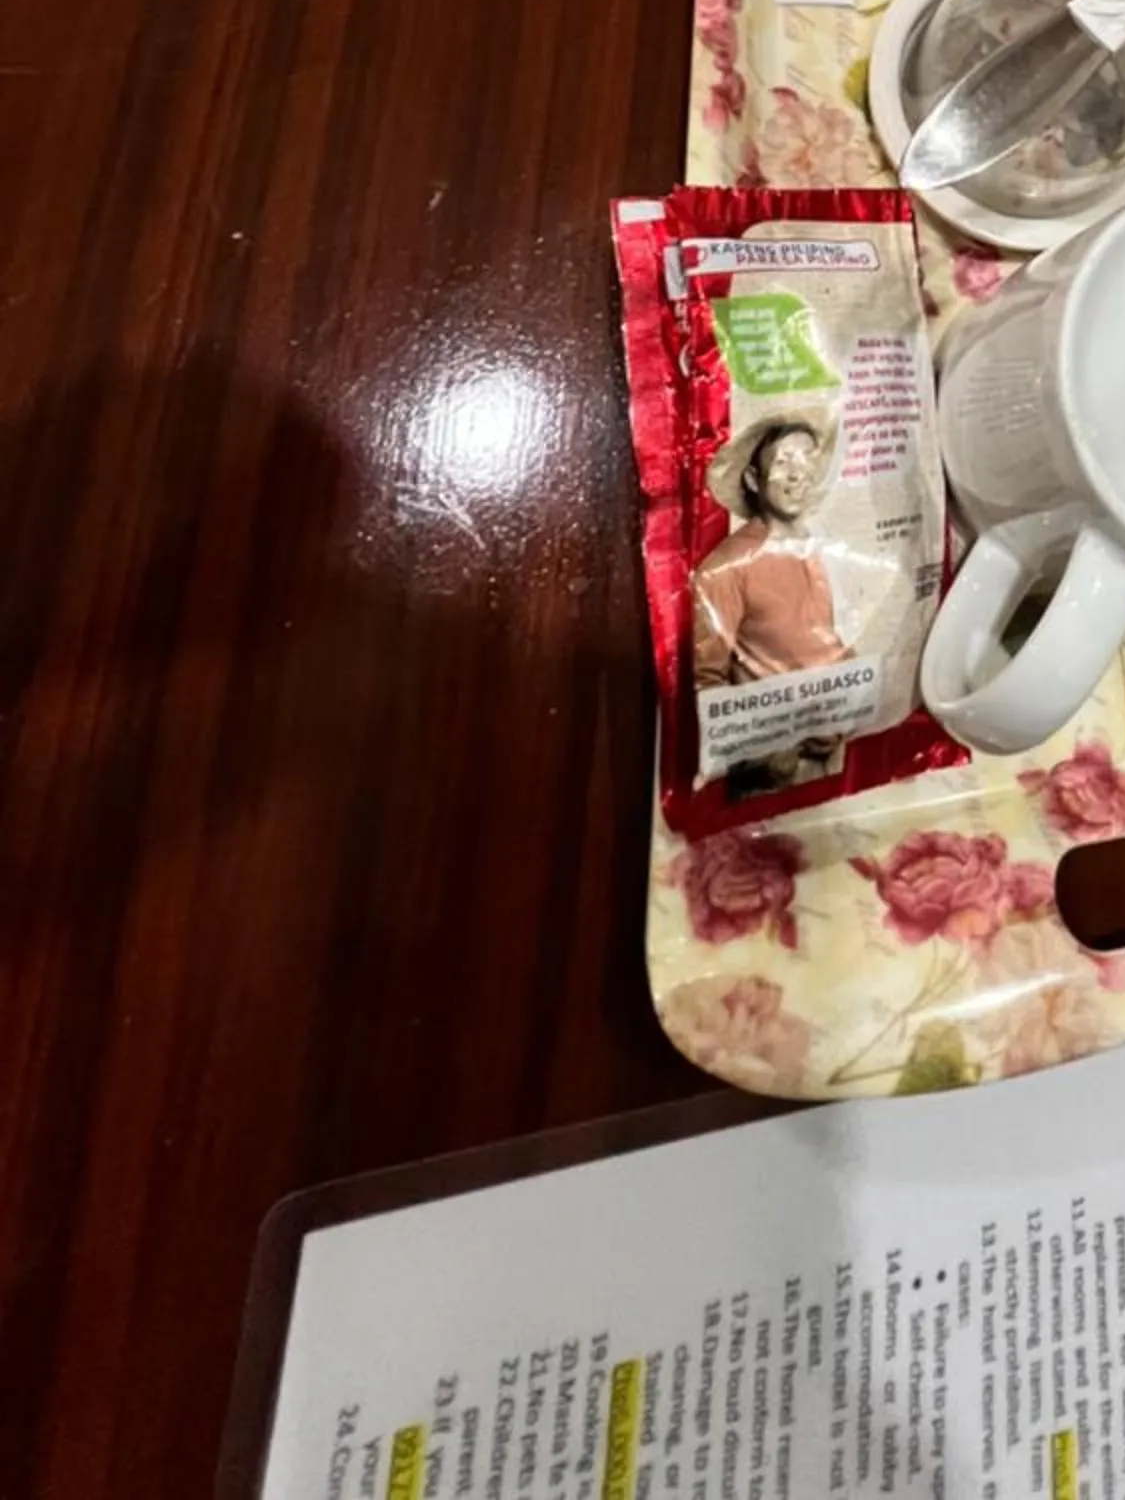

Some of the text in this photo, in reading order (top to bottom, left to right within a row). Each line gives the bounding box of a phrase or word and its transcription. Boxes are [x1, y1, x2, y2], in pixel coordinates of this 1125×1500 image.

[708, 668, 874, 718] BENROSE SUBASCO
[708, 722, 749, 739] Coffee
[957, 1261, 971, 1329] cases:
[1003, 1247, 1019, 1319] strictly
[1050, 1234, 1065, 1342] otherwise
[1073, 1266, 1085, 1333] rooms
[755, 1320, 772, 1360] not
[933, 1303, 948, 1377] Failure
[981, 1306, 996, 1363] hotel
[1093, 1222, 1113, 1436] replacement for the
[724, 1367, 744, 1423] loud
[778, 1362, 797, 1425] hotel
[831, 1348, 848, 1410] hotel
[1029, 1360, 1044, 1423] items
[1075, 1346, 1088, 1386] and
[638, 1350, 663, 1445] Stained
[749, 1367, 770, 1469] conform
[981, 1374, 996, 1473] reserves
[514, 1433, 539, 1488] pets
[879, 1424, 898, 1492] lobby
[930, 1417, 945, 1457] pay
[1029, 1436, 1045, 1491] from
[1074, 1399, 1090, 1466] public
[354, 1436, 382, 1497] your
[419, 1446, 445, 1499] you
[828, 1448, 845, 1490] not
